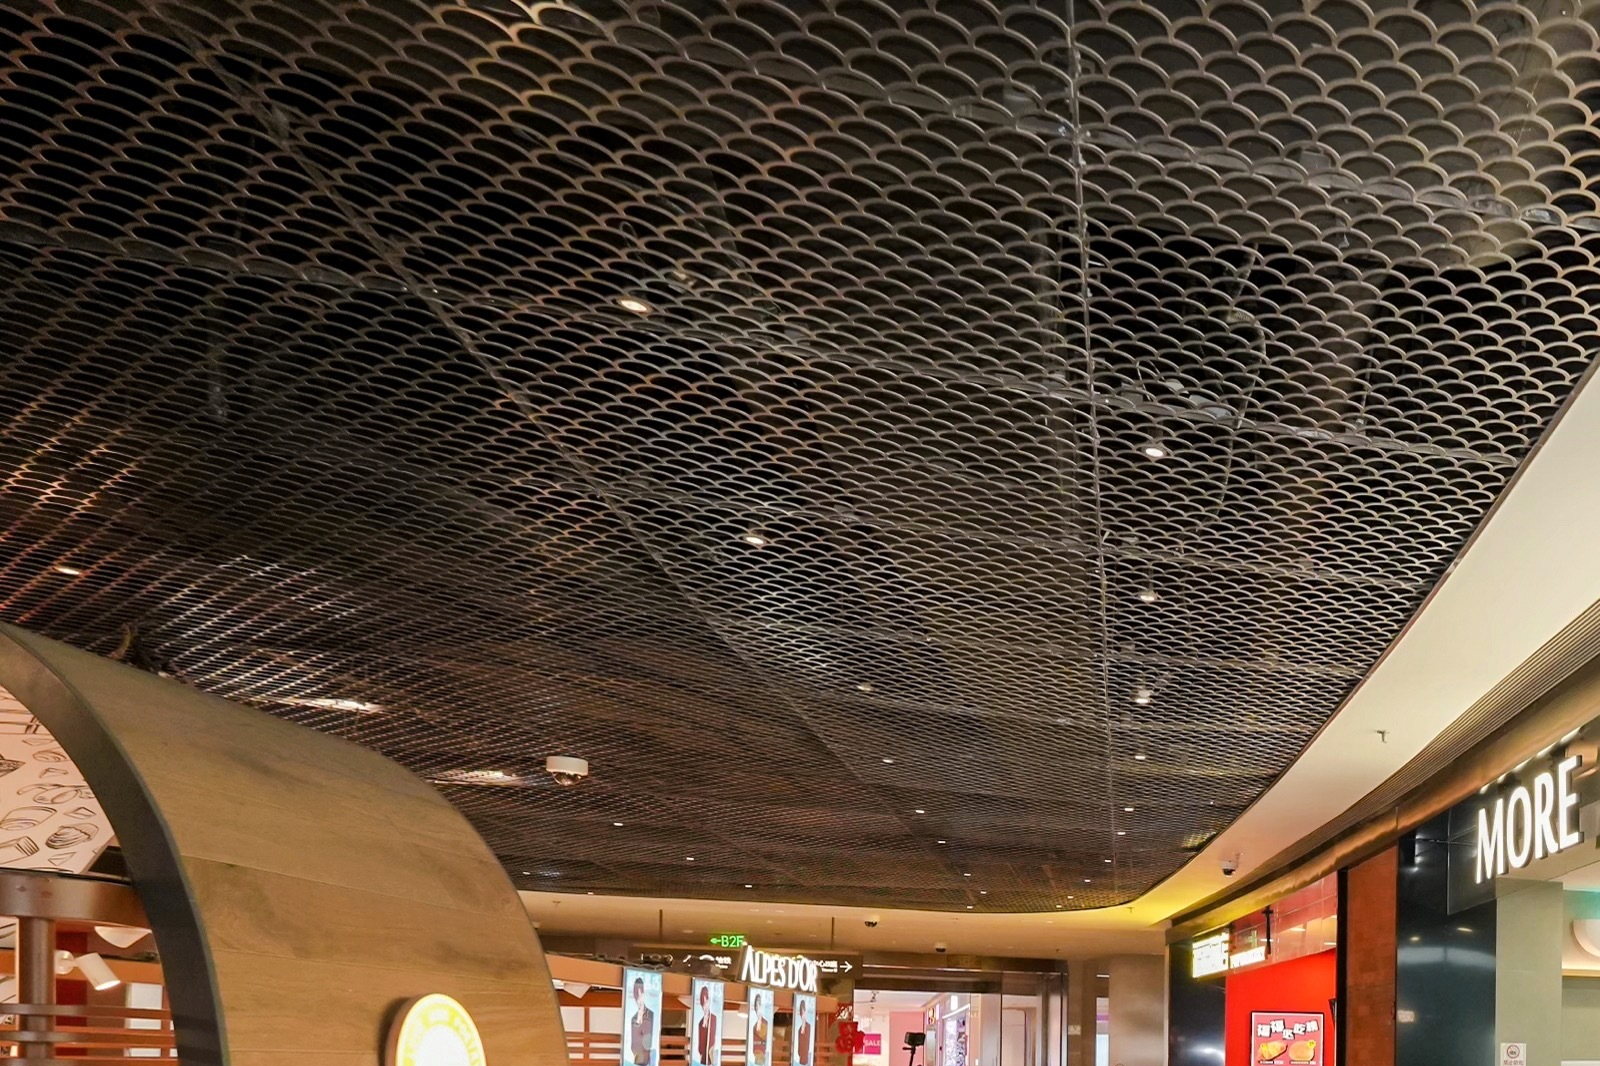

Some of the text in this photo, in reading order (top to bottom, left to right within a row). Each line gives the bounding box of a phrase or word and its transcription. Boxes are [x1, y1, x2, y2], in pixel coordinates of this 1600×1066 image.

[1475, 755, 1584, 884] MORE
[721, 935, 745, 948] B2F
[741, 944, 787, 988] ALPES
